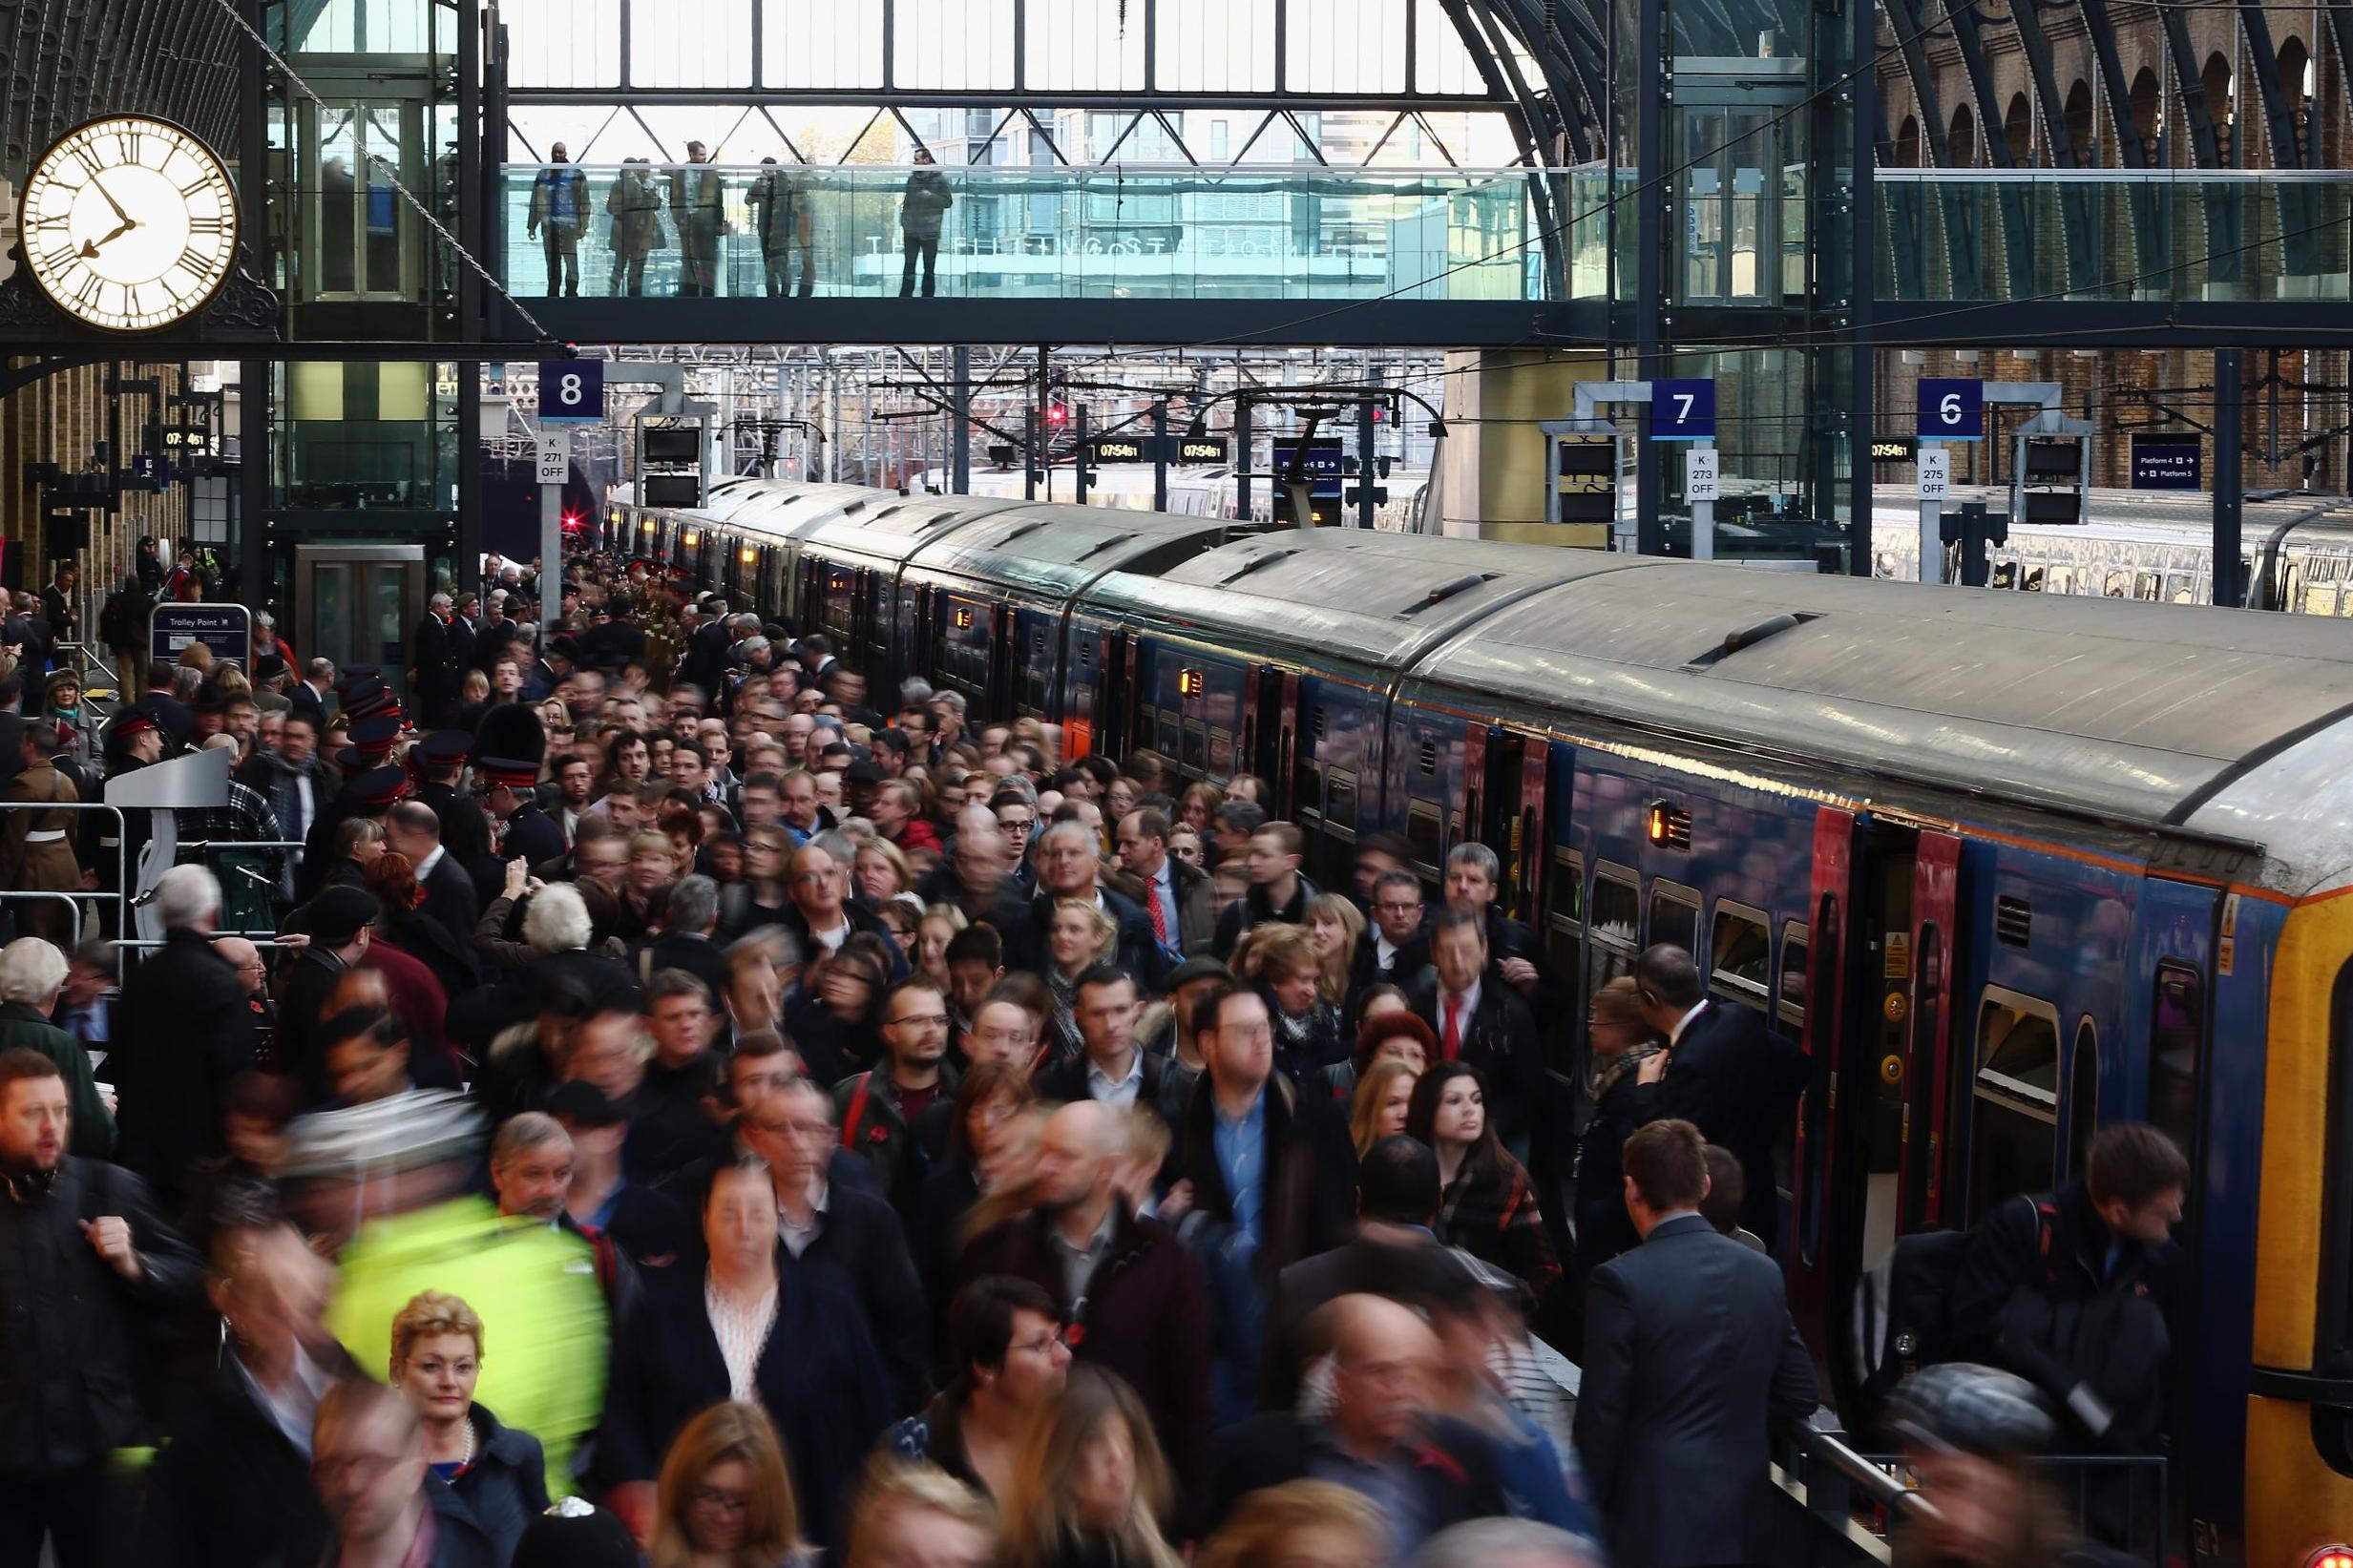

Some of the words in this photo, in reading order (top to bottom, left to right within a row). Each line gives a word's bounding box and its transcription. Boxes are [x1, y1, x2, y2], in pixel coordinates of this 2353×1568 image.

[560, 373, 582, 406] 8
[1672, 394, 1694, 424] 7
[1940, 393, 1963, 425] 6
[549, 439, 556, 448] K
[544, 453, 561, 462] 271
[1698, 456, 1705, 465] K
[1929, 456, 1937, 465] K
[541, 468, 564, 477] OFF
[1692, 470, 1712, 479] 273
[1923, 470, 1943, 479] 275
[1691, 485, 1713, 493] OFF
[1922, 485, 1944, 493] OFF
[170, 618, 196, 627] Trolley
